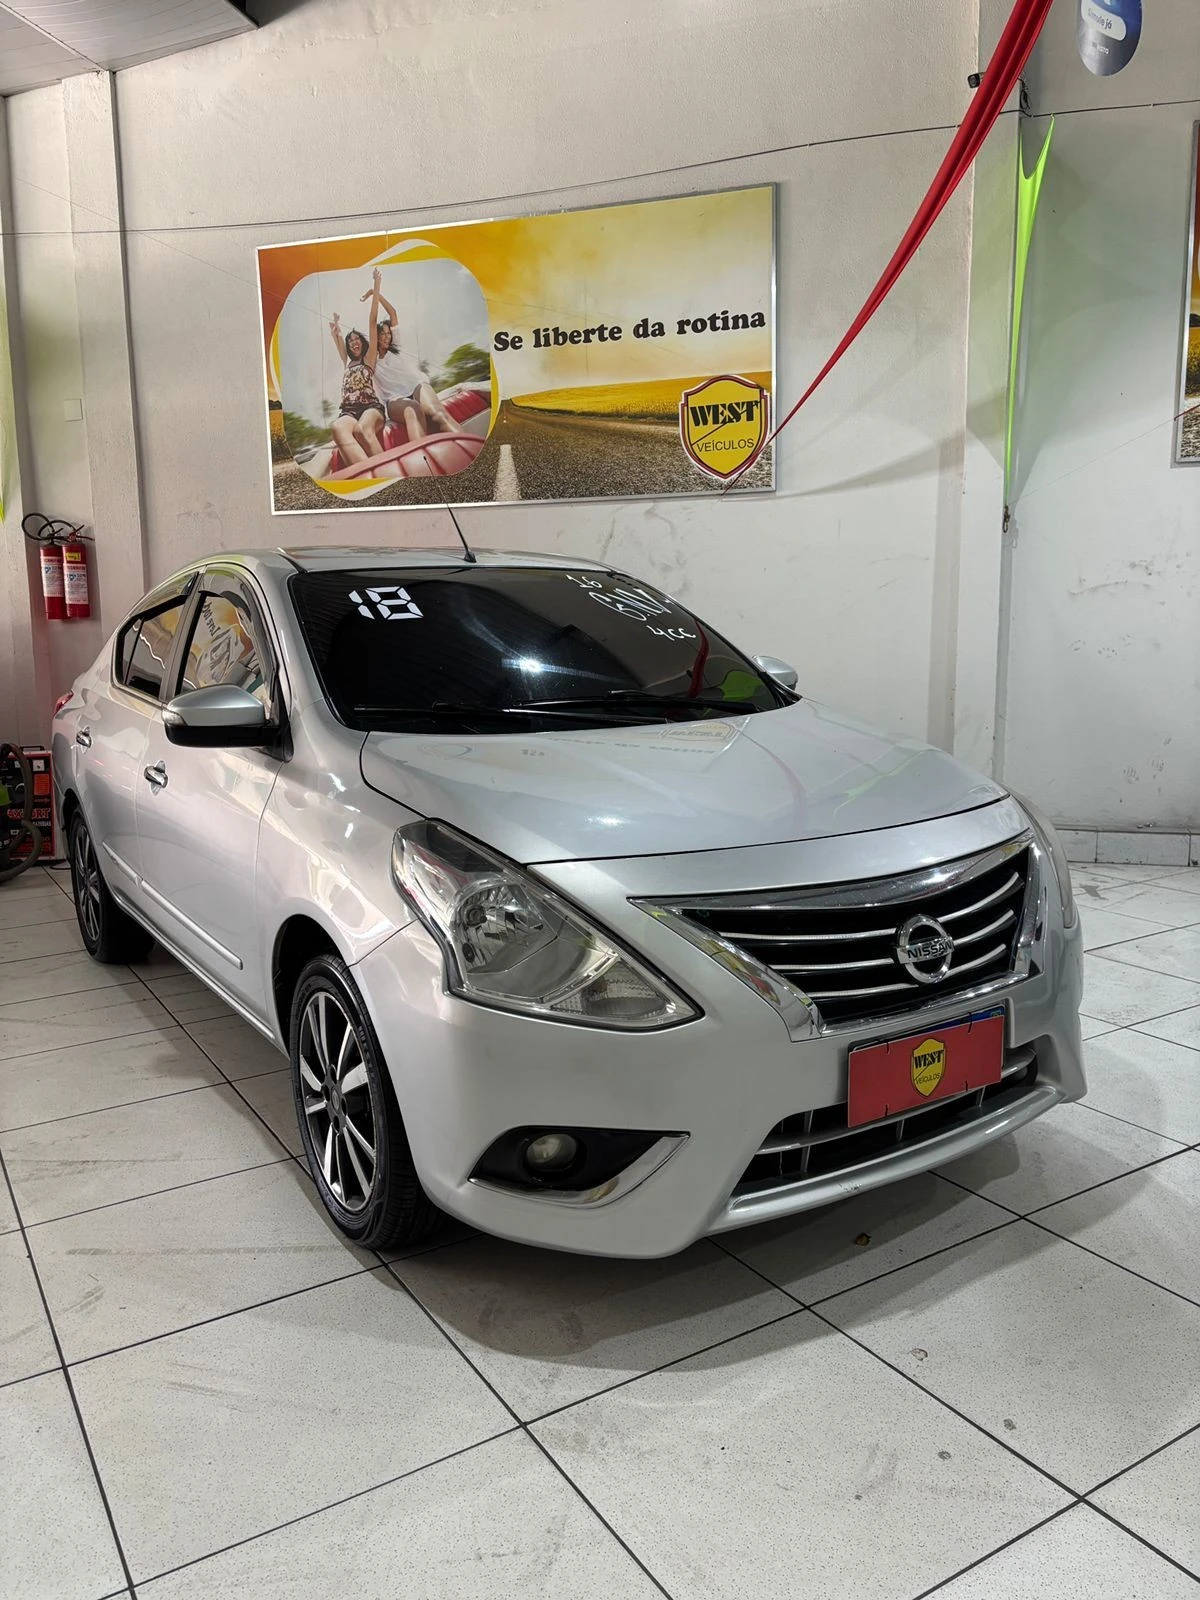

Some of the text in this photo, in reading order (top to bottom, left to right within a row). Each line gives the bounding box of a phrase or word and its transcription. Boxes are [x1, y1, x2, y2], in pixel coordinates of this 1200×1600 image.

[494, 310, 766, 351] Se liberte da rotina
[690, 400, 760, 427] WEST
[697, 438, 754, 452] VEÍCULOS
[348, 586, 425, 620] 18
[907, 939, 954, 959] NISSAN
[914, 1049, 944, 1069] WEST
